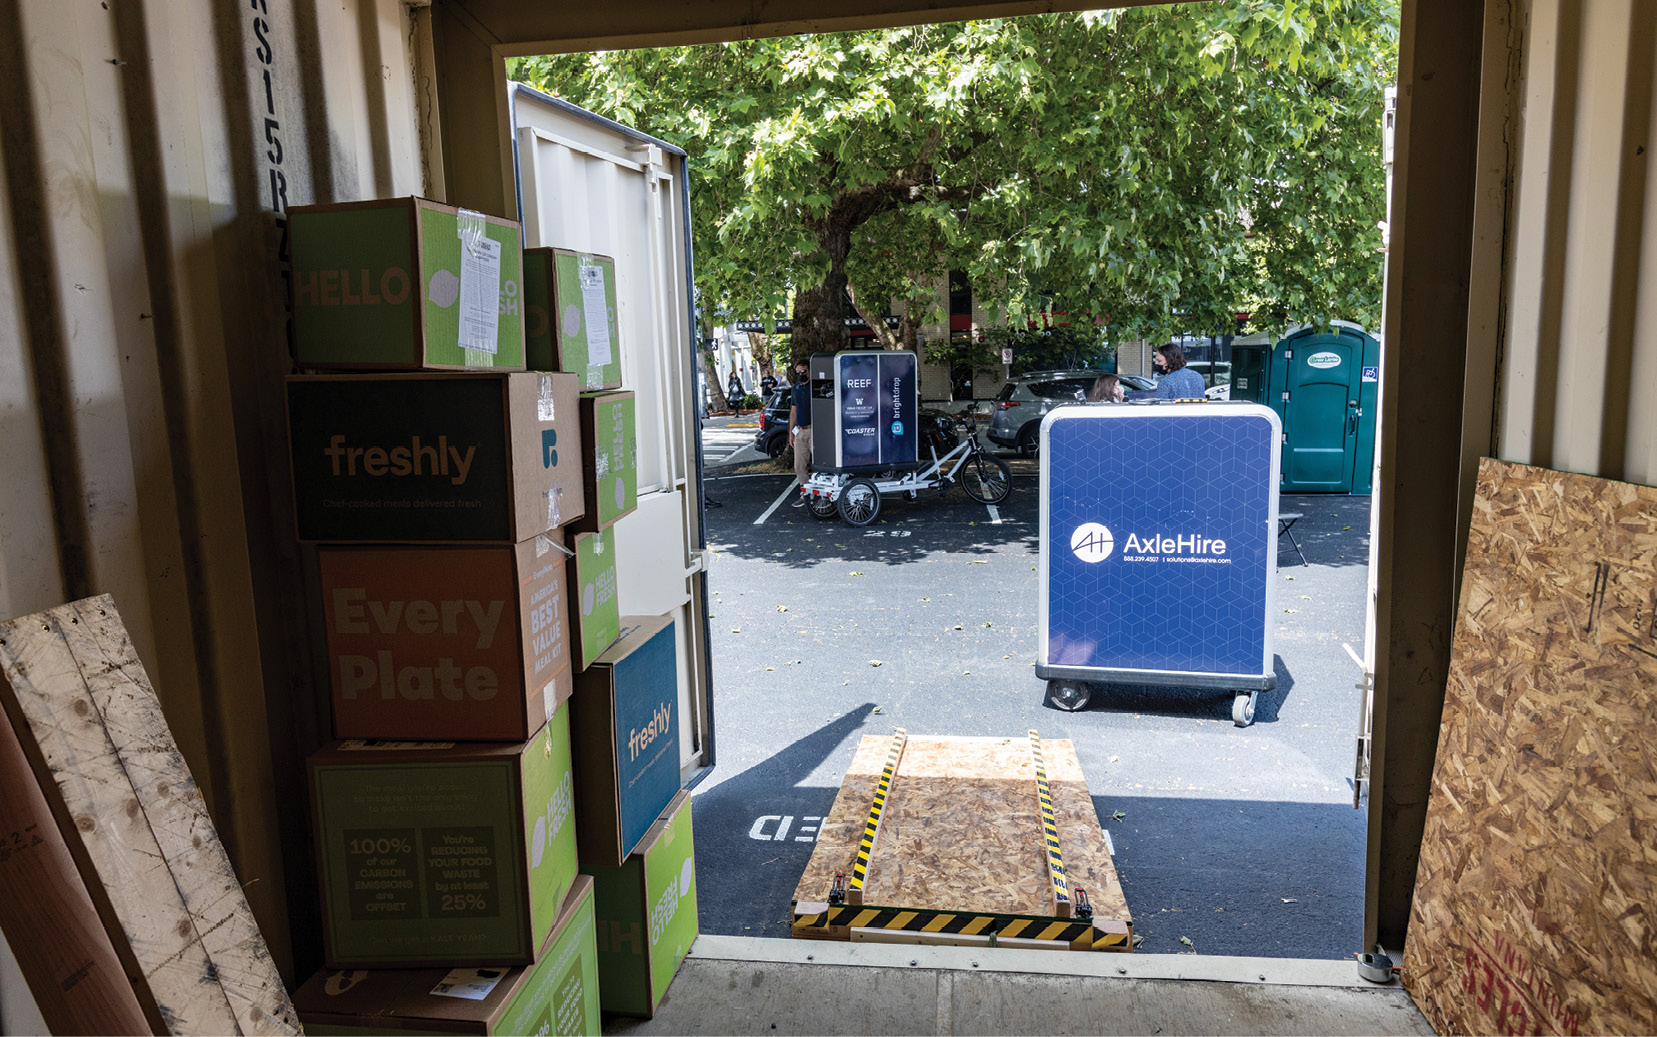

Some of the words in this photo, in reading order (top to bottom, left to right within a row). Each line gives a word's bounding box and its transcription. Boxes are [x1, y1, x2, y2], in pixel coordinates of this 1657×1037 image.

[293, 266, 411, 306] HELLO
[847, 379, 872, 389] REEF
[893, 377, 902, 419] brightdrop
[324, 433, 477, 486] freshly
[323, 499, 381, 509] Chef-cooked
[384, 499, 411, 509] meals
[413, 499, 455, 509] delivered
[458, 499, 482, 509] fresh
[1123, 533, 1227, 555] AxleHire
[595, 565, 614, 593] HELLO
[530, 580, 559, 606] AMERICA'S
[596, 580, 616, 608] FRESH
[332, 587, 505, 649] Every
[531, 594, 559, 636] BEST
[532, 621, 561, 657] VALUE
[535, 655, 552, 675] MEAL
[552, 643, 561, 664] KIT
[338, 649, 500, 701] Plate
[628, 702, 672, 762] freshly
[547, 770, 570, 824] HELLO
[548, 789, 572, 847] FRESH
[350, 837, 412, 854] 100%
[431, 846, 488, 856] REDUCING
[442, 835, 474, 844] You're
[360, 869, 406, 878] CARBON
[366, 856, 378, 866] of
[380, 858, 397, 866] our
[428, 858, 458, 868] YOUR
[461, 857, 493, 867] FOOD
[442, 869, 480, 879] WASTE
[355, 880, 414, 889] EMISSIONS
[376, 892, 394, 900] are
[435, 881, 448, 892] by
[450, 881, 461, 890] at
[464, 881, 489, 890] least
[365, 902, 406, 912] OFFSET
[441, 893, 486, 912] 25%
[651, 874, 678, 928] FRESH
[652, 892, 679, 946] HELLO
